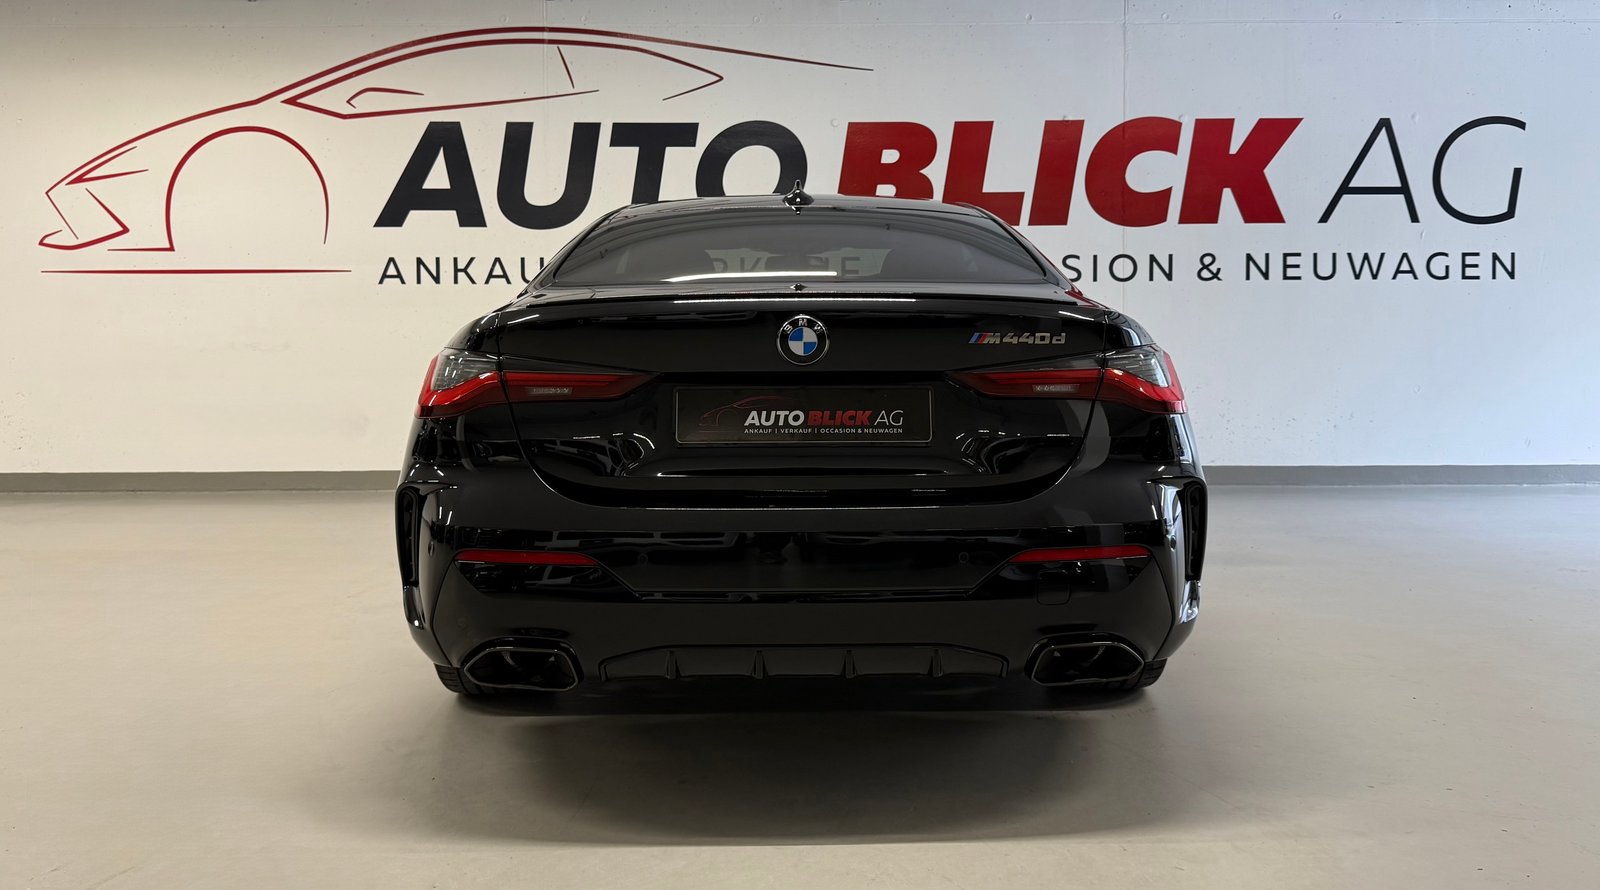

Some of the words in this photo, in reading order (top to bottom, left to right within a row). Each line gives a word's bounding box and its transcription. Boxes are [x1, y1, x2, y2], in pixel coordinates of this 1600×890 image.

[373, 120, 808, 230] AUTO
[837, 116, 1304, 228] BLICK
[1317, 115, 1527, 225] AG
[378, 256, 545, 285] ANKAU
[1061, 252, 1174, 283] SION
[1196, 252, 1223, 282] &
[1245, 251, 1516, 282] NEUWAGEN
[969, 332, 1066, 345] M440d
[744, 410, 805, 427] AUTO
[807, 410, 873, 426] BLICK
[874, 409, 904, 426] AG
